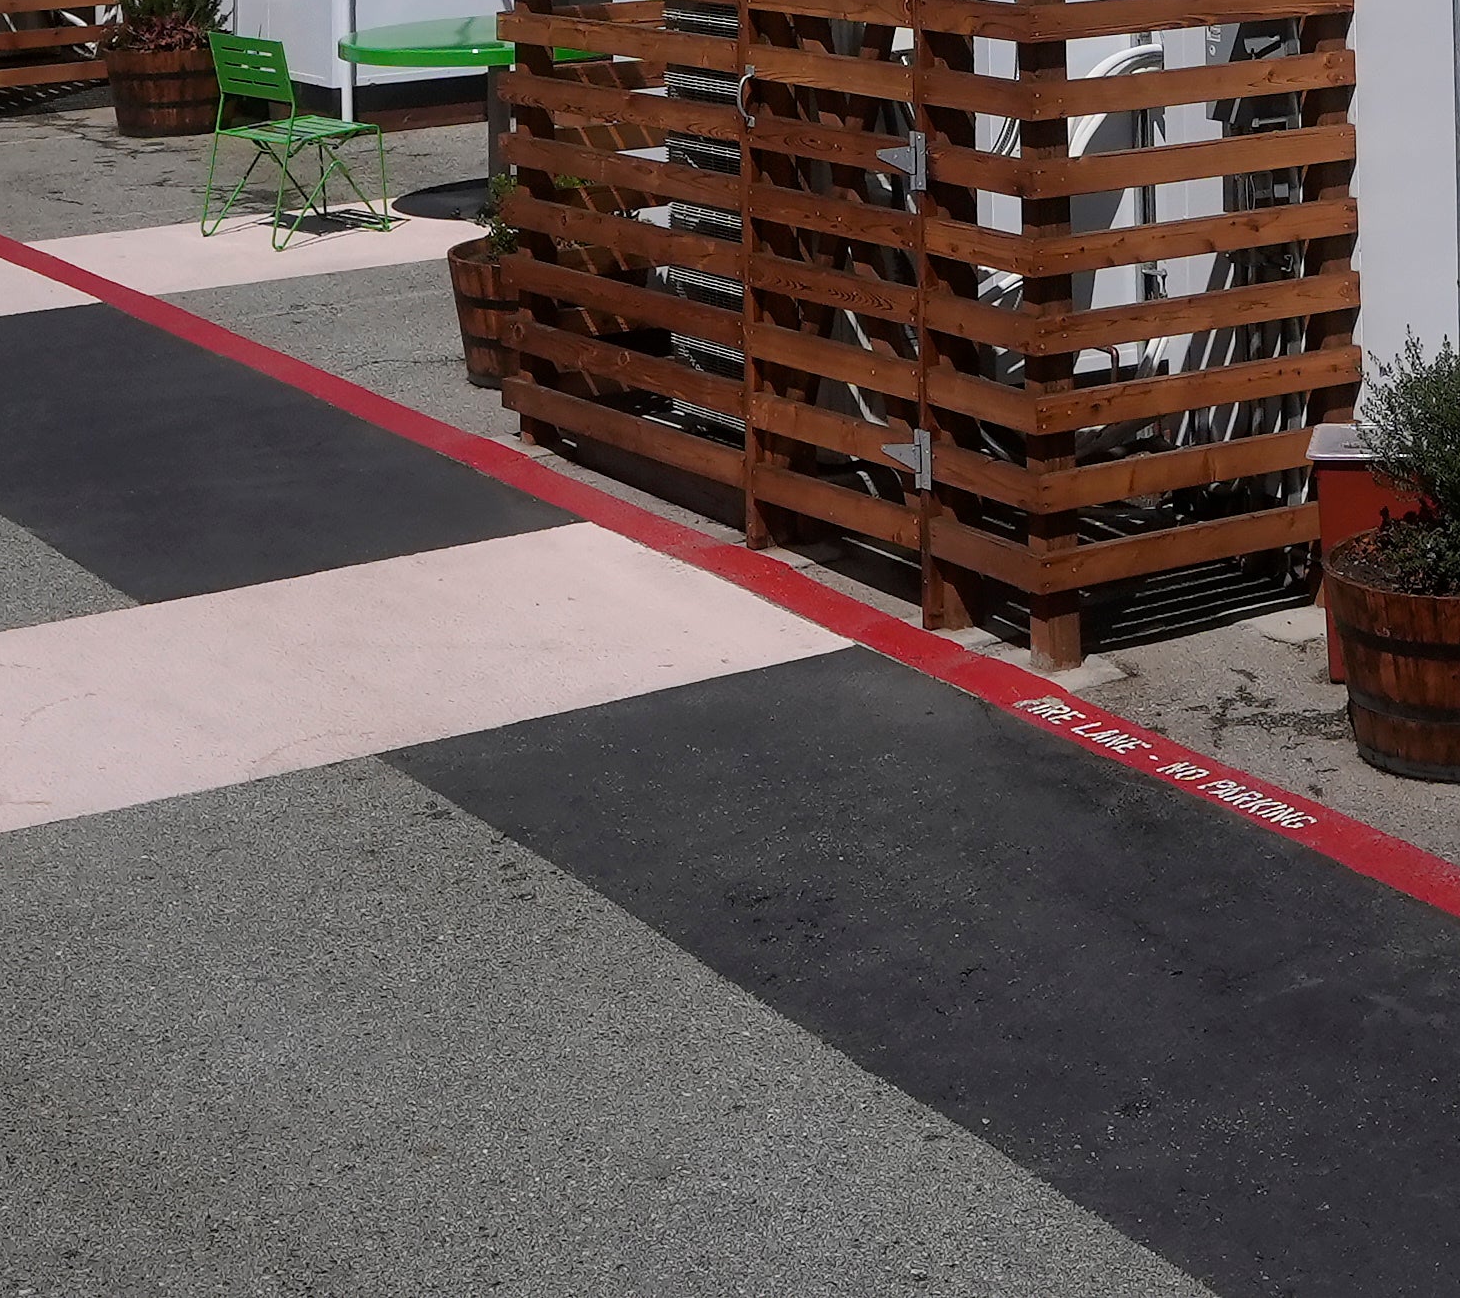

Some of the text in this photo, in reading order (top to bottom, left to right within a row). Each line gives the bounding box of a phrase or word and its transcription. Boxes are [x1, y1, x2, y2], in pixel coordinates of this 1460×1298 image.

[1071, 722, 1153, 754] LANE
[1156, 761, 1210, 781] NO
[1196, 778, 1318, 829] PARKING
